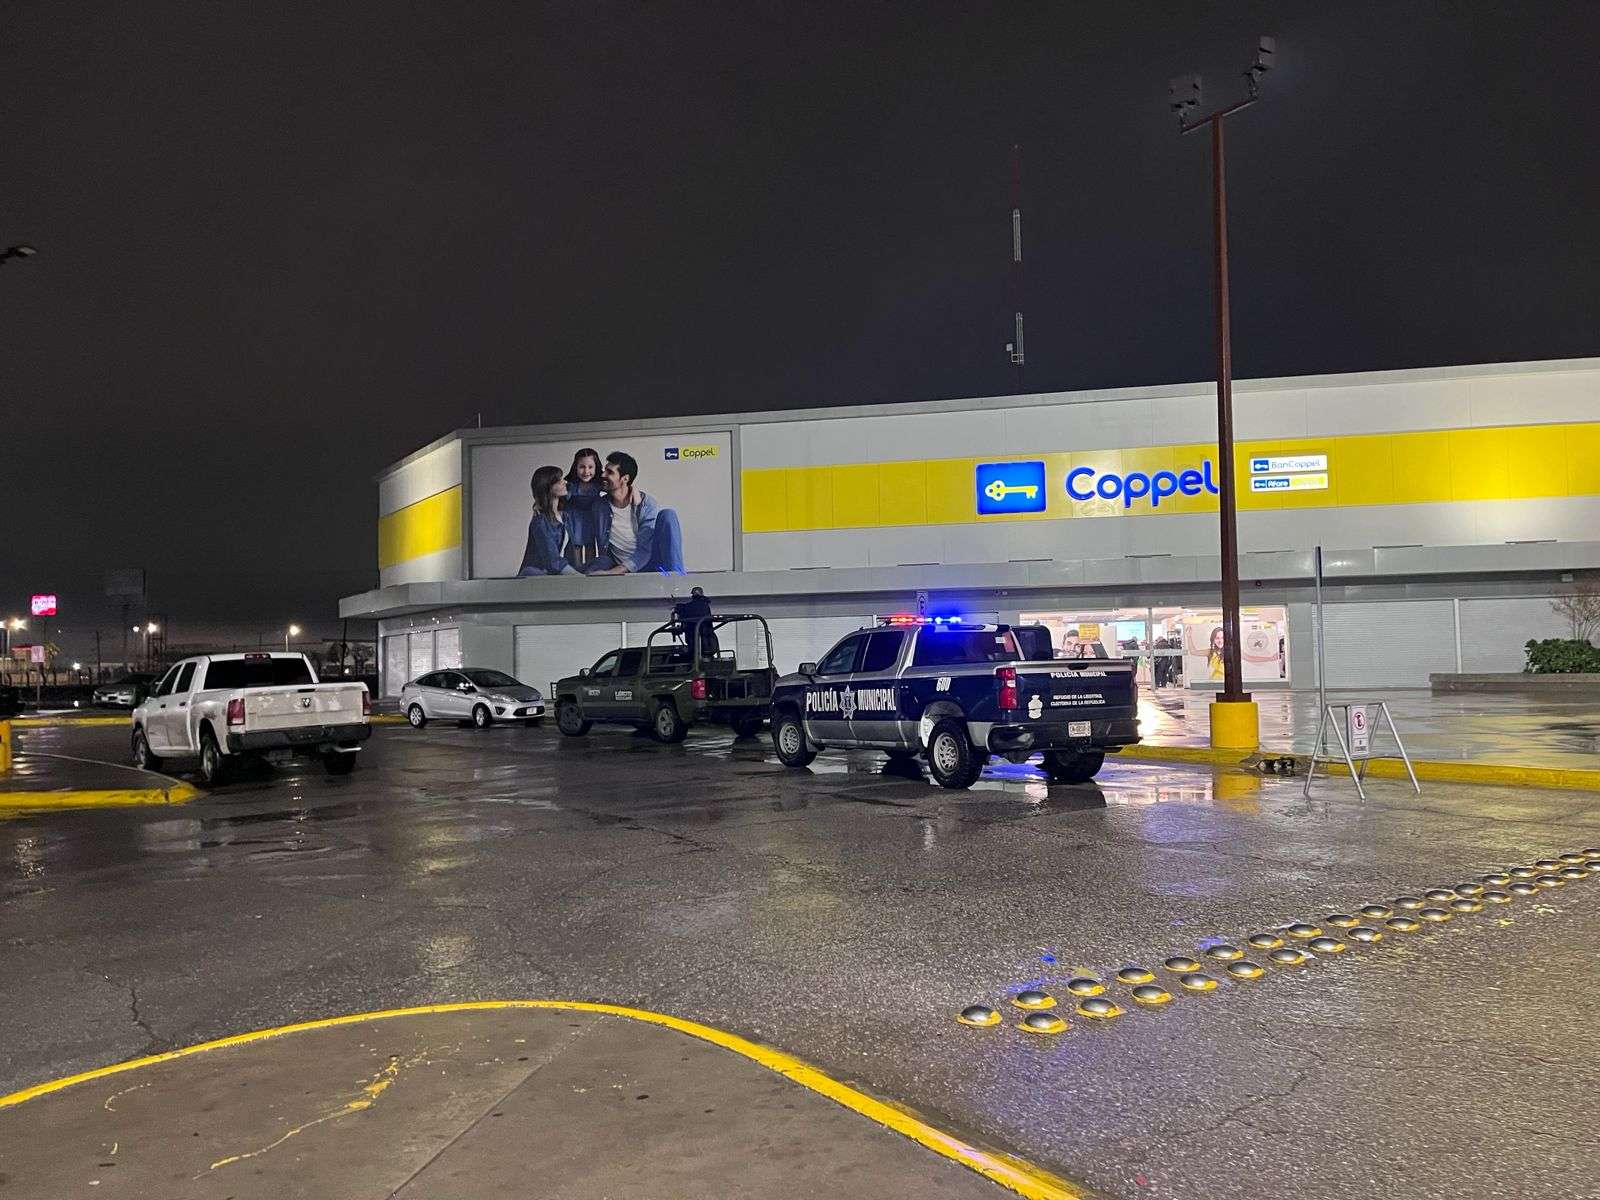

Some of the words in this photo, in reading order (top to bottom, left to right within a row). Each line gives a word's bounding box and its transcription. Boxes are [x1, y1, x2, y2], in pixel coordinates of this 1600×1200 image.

[682, 448, 716, 459] Coppel
[1271, 460, 1320, 469] BanCoppel
[1066, 460, 1219, 508] Coppel
[806, 688, 838, 711] POLICÍA
[858, 689, 896, 710] MUNICIPAL
